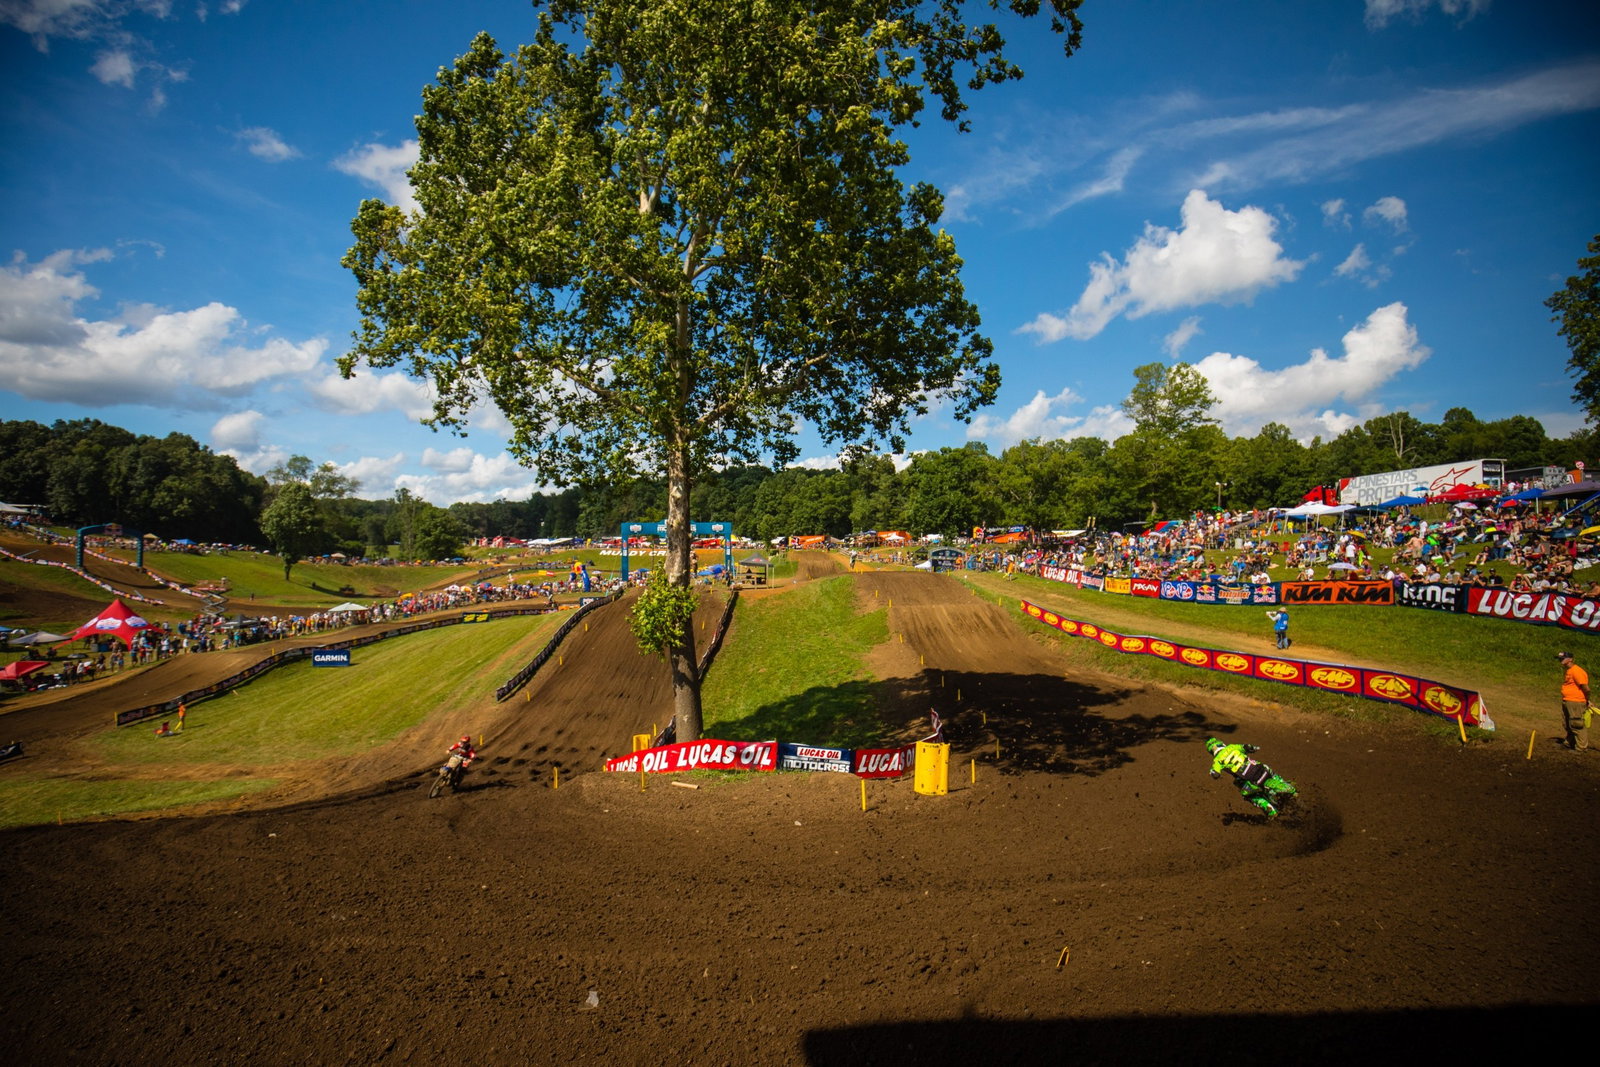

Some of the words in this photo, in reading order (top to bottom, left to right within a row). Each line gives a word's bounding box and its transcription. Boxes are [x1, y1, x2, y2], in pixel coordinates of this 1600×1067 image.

[1043, 566, 1066, 581] LUCAS
[1066, 570, 1079, 584] OIL
[1284, 584, 1332, 602] KTM
[1336, 583, 1391, 602] KTM
[1477, 590, 1567, 621] LUCAS
[1571, 601, 1600, 628] OI
[314, 654, 347, 662] GARMIN
[1260, 662, 1298, 675] FMF
[1312, 670, 1353, 683] FMF
[643, 750, 669, 771] OIL
[677, 743, 737, 768] LUCAS
[740, 744, 771, 766] OIL
[799, 748, 826, 758] LUCAS
[827, 750, 840, 759] OIL
[858, 750, 905, 773] LUCAS
[783, 759, 851, 774] MOTOCROSS
